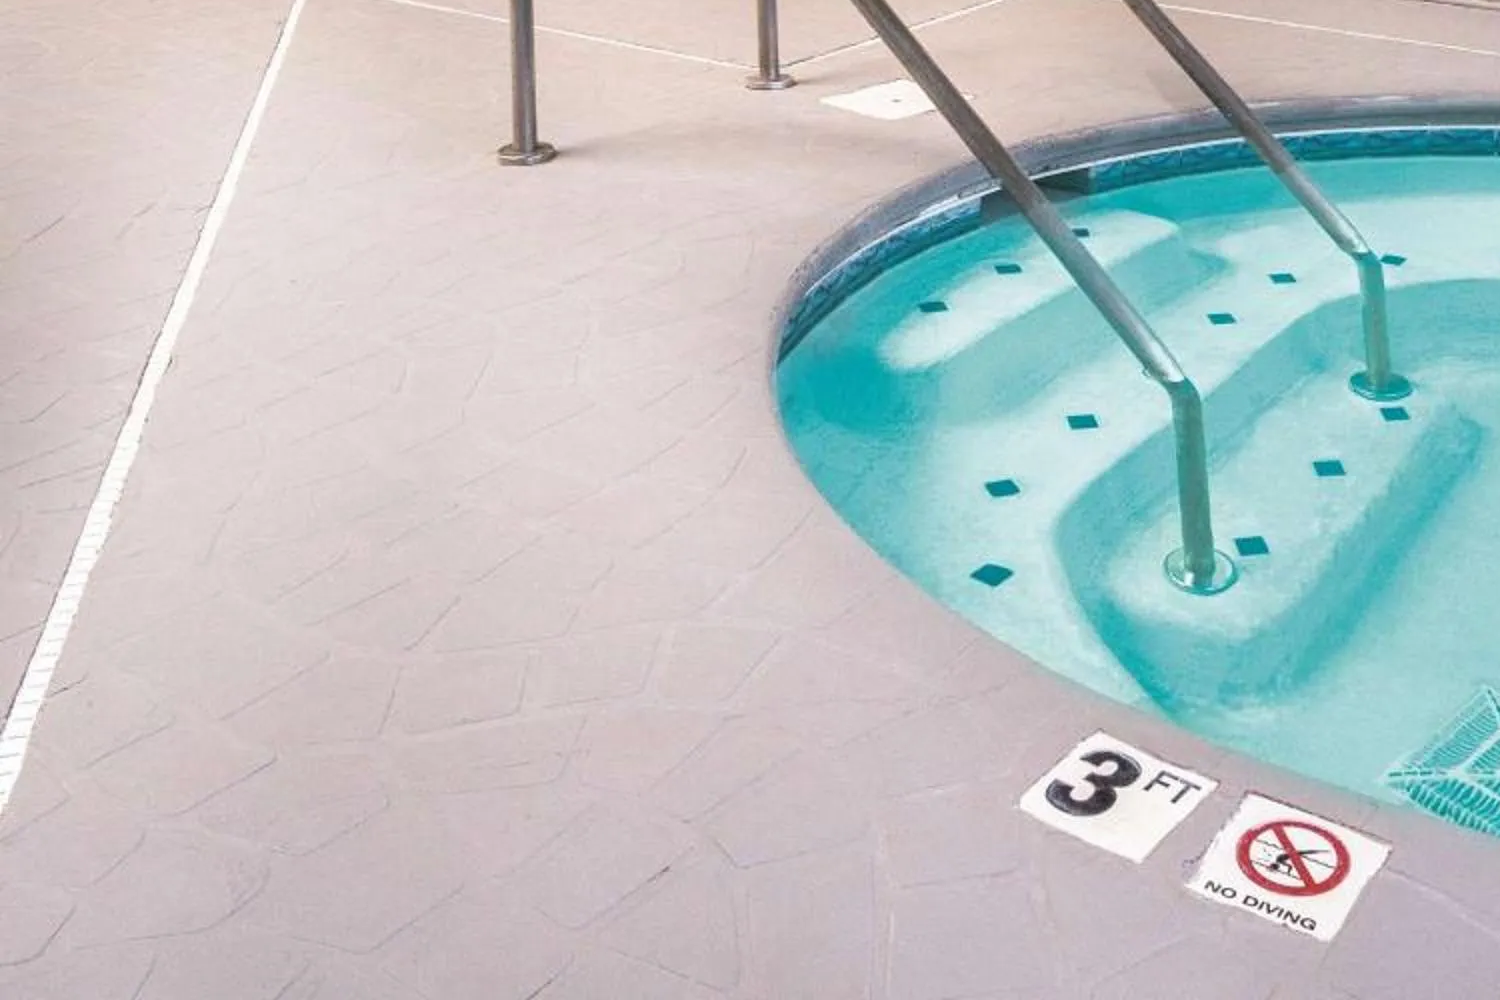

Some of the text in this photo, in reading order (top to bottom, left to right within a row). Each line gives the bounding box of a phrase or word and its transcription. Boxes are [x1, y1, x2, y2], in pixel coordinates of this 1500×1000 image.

[1045, 750, 1201, 816] 3 FT
[1204, 879, 1318, 932] NO DIVING
